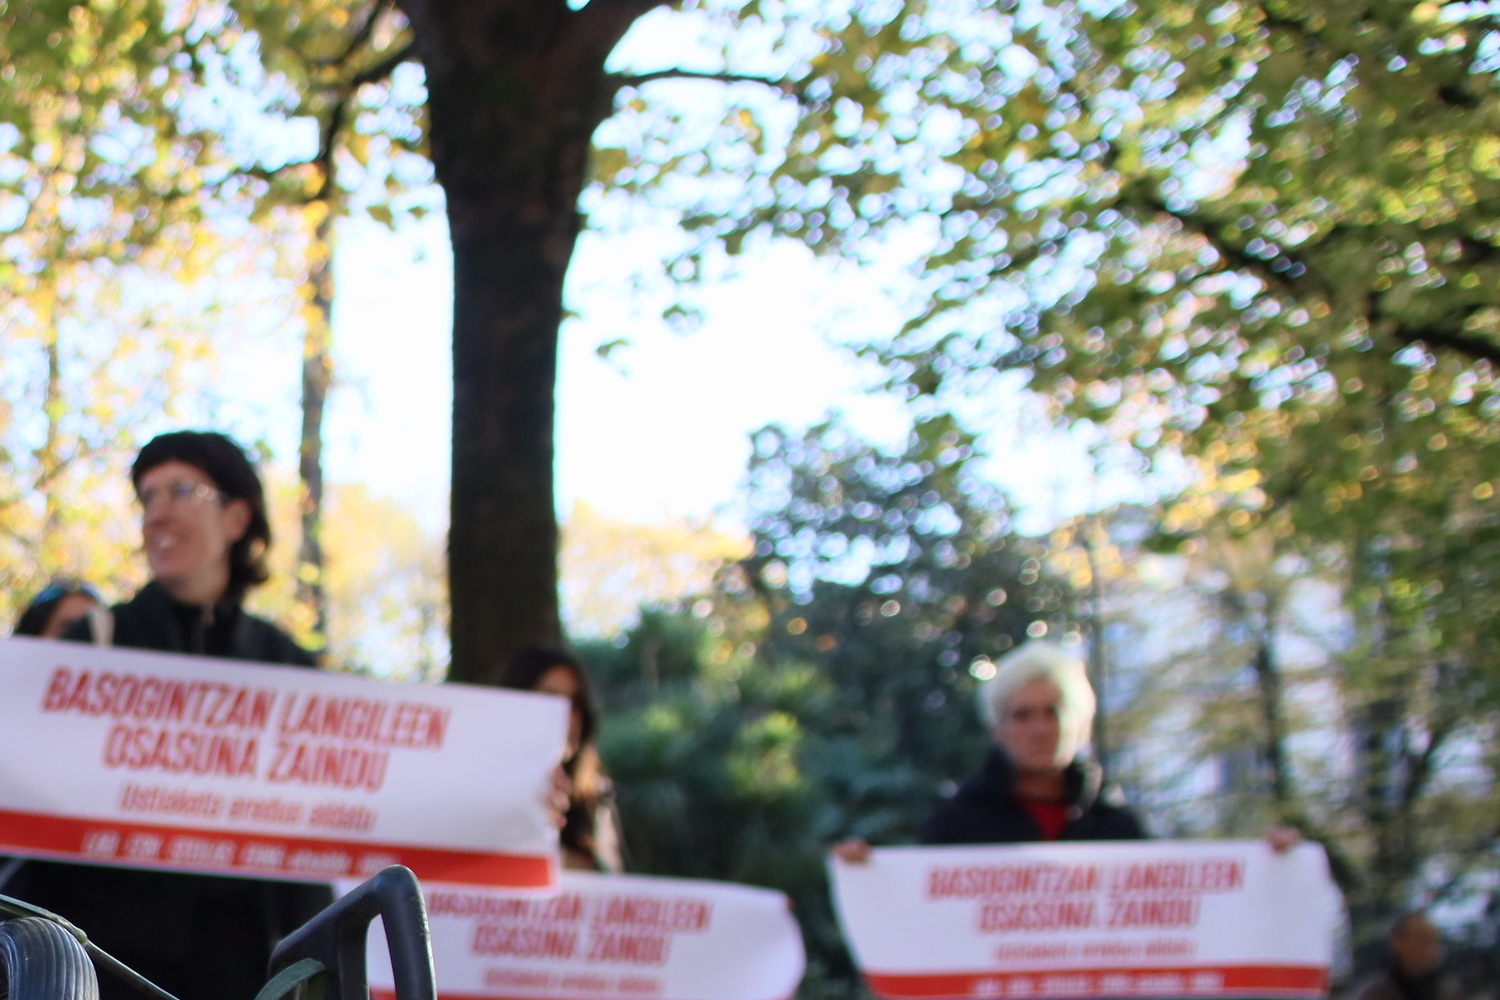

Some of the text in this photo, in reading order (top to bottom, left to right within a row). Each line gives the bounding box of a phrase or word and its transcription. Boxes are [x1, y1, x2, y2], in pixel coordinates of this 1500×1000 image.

[41, 664, 452, 750] BASOGINTZAN LANGILEEN
[103, 723, 390, 793] OSASUNA ZAINDU
